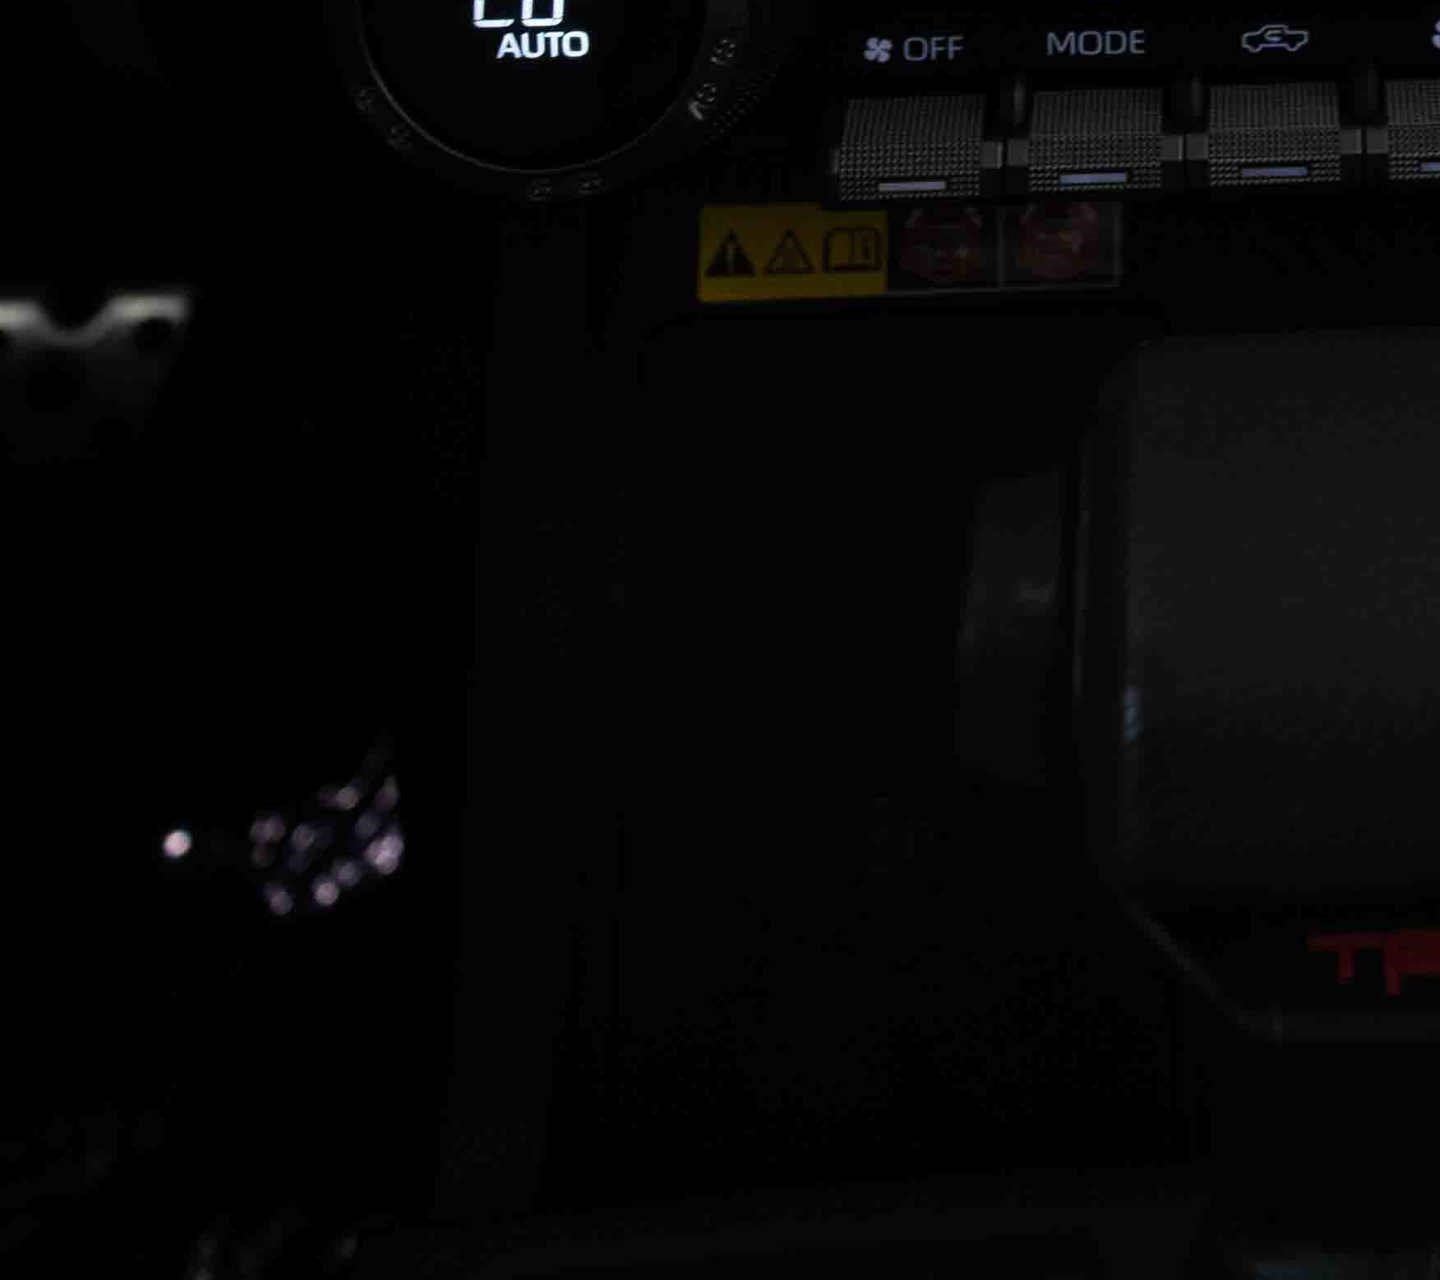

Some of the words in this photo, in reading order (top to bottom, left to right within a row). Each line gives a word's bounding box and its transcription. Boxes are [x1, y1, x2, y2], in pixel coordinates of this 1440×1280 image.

[495, 30, 591, 60] AUTO
[902, 35, 965, 62] OFF
[1046, 29, 1146, 56] MODE
